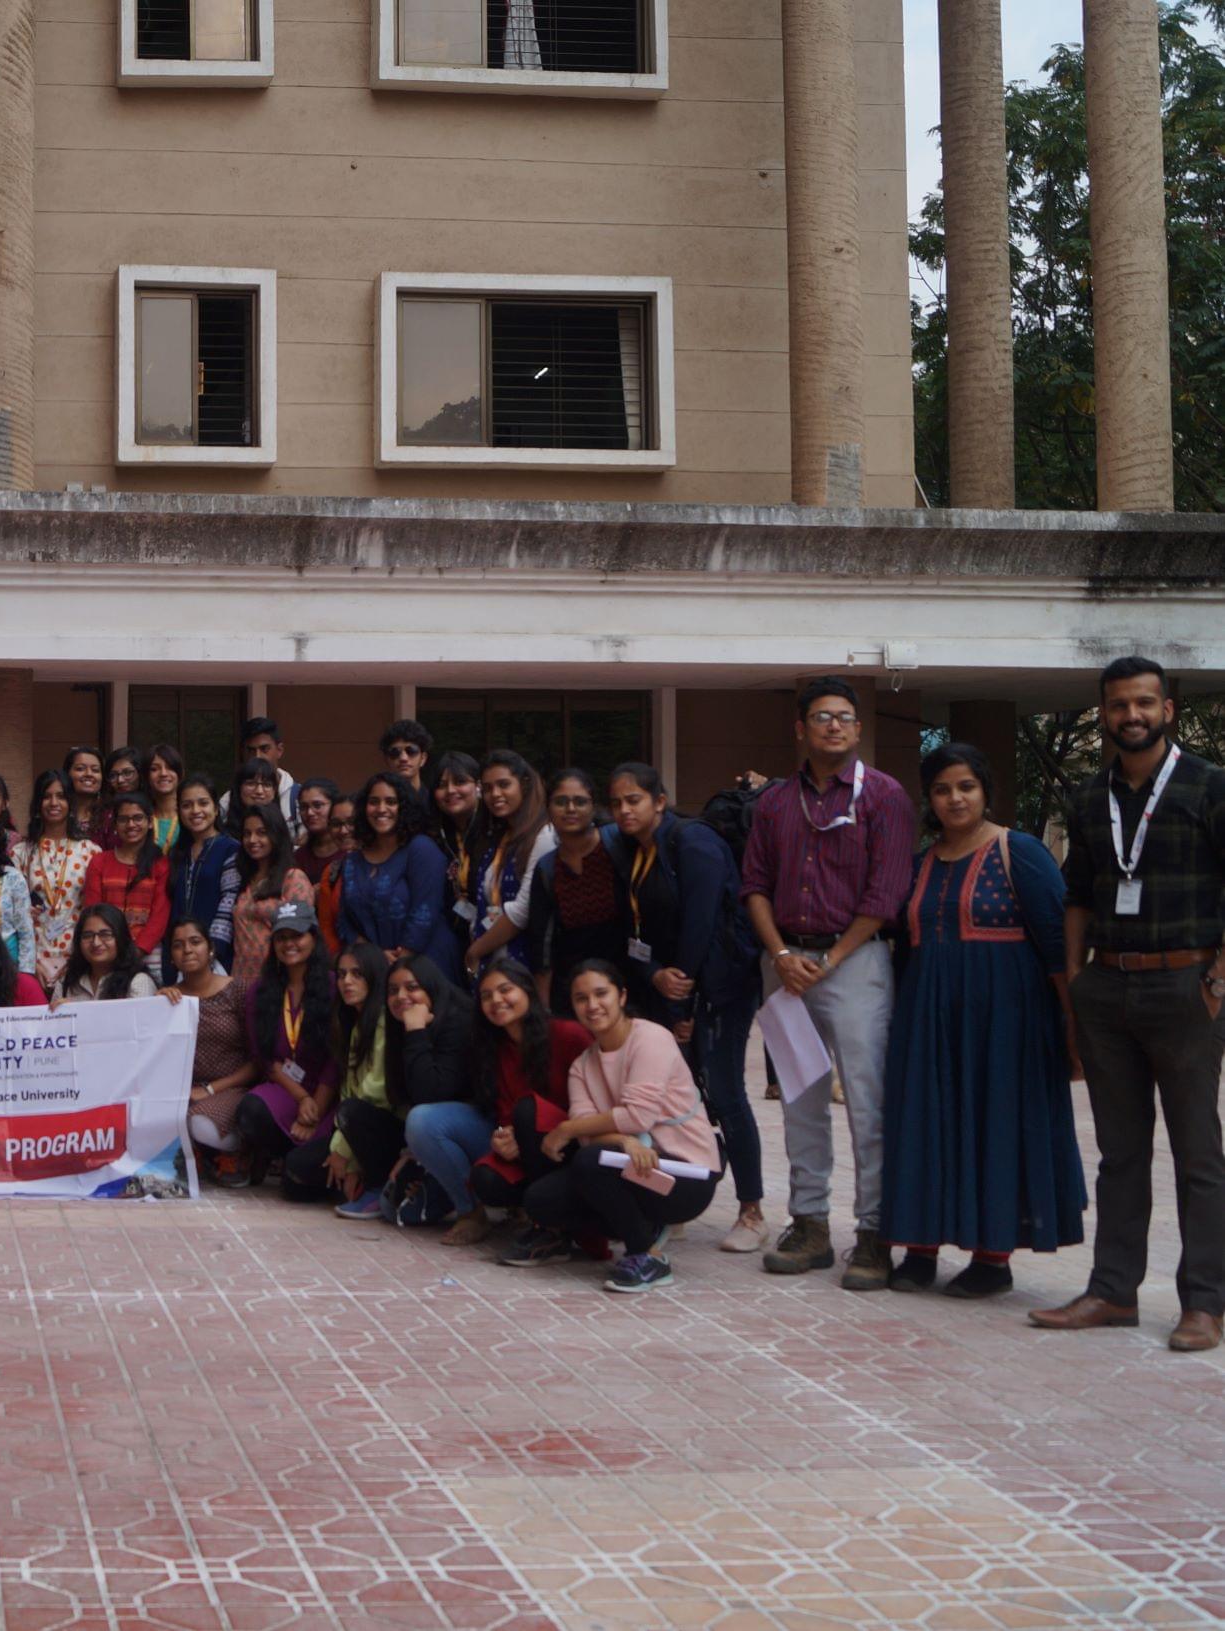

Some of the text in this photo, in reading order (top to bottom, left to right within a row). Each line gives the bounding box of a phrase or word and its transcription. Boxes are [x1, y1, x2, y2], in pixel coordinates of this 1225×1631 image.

[21, 1035, 78, 1050] PEACE
[33, 1056, 60, 1066] PUNE
[21, 1087, 80, 1101] University
[5, 1127, 115, 1162] PROGRAM
